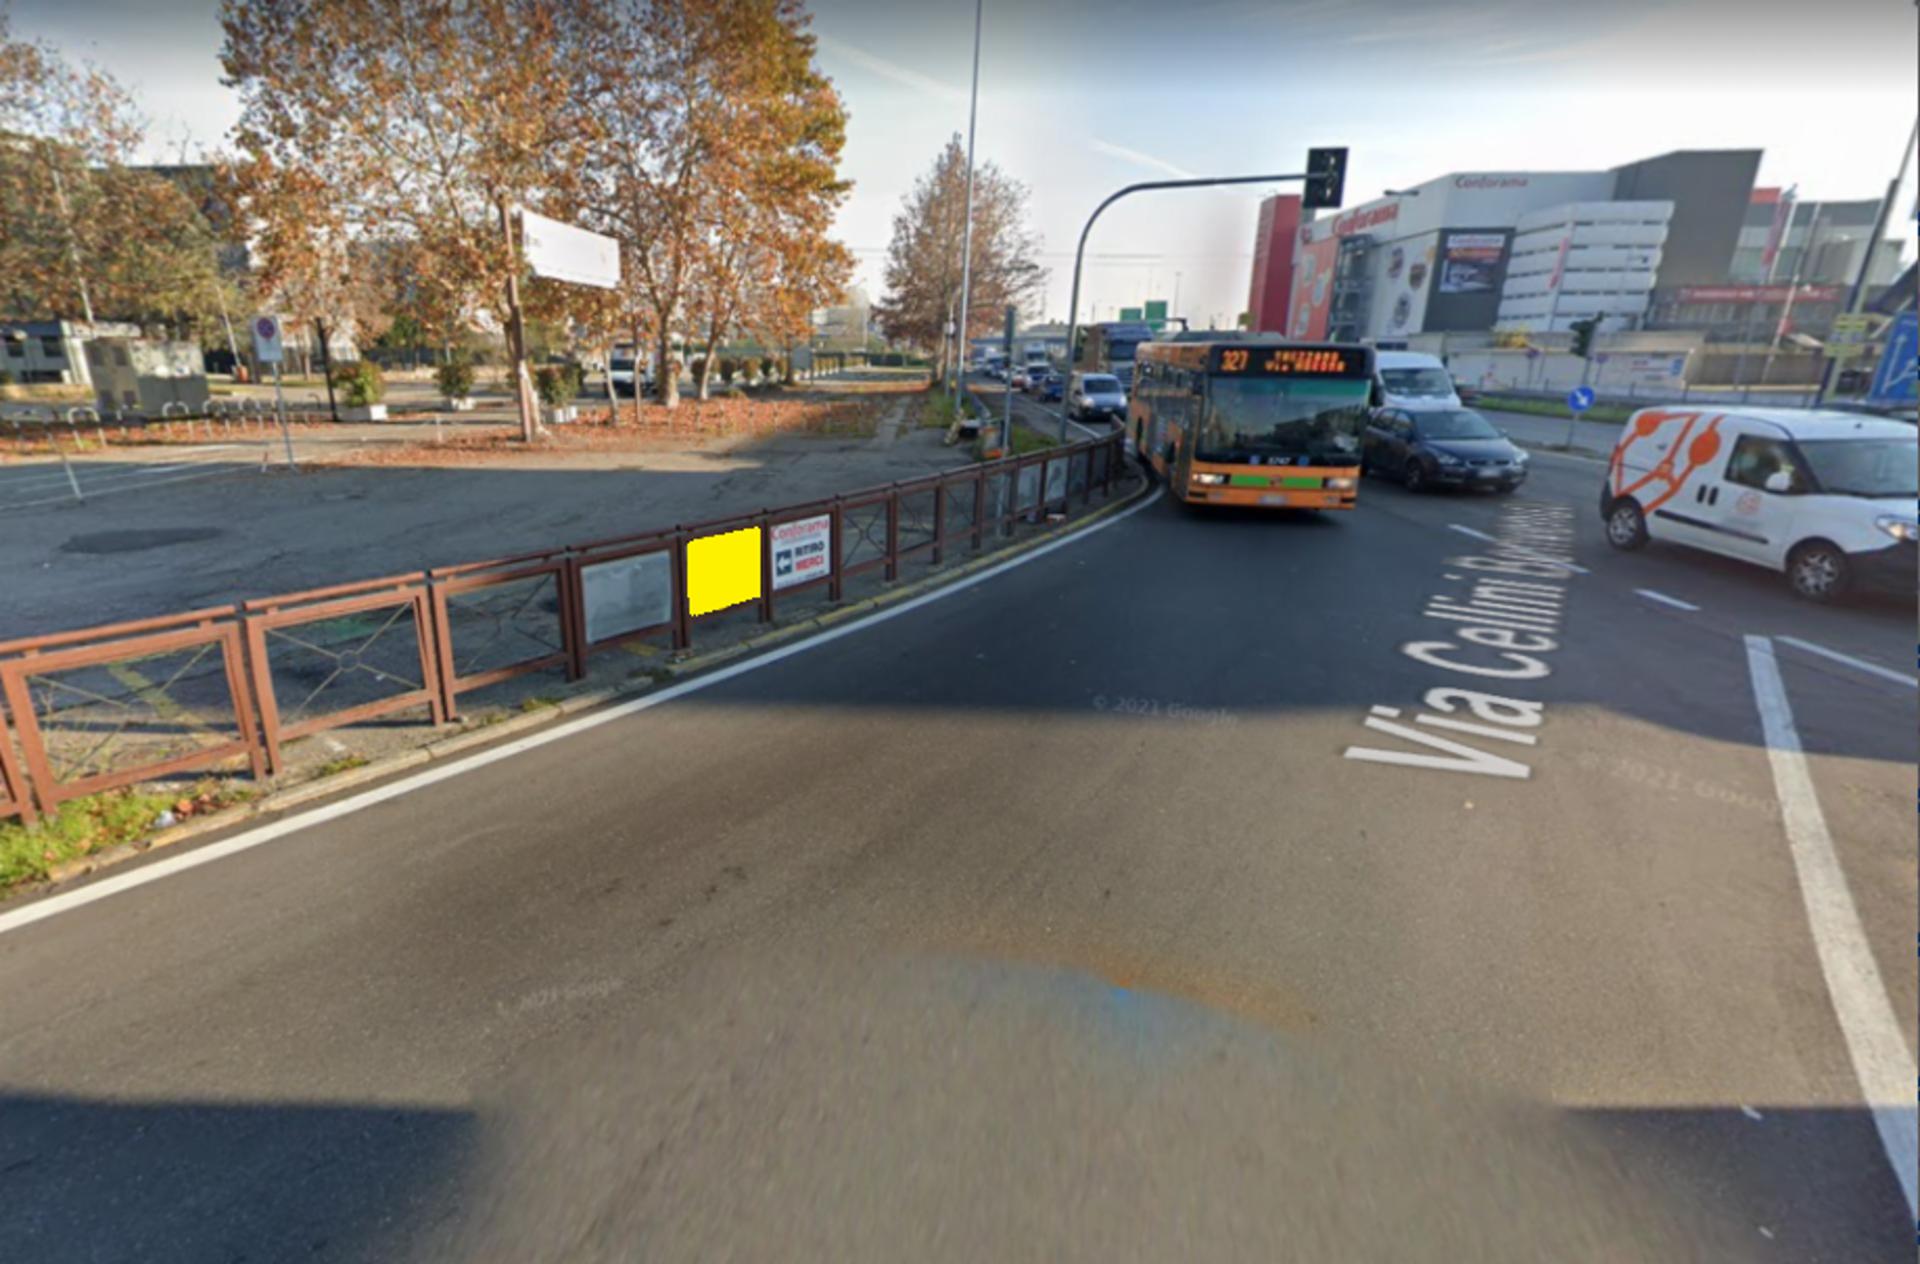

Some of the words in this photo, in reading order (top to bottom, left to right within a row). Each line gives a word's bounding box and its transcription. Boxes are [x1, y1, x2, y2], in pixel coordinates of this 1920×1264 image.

[1455, 174, 1528, 189] Conforama
[1221, 350, 1249, 371] 327
[770, 519, 829, 541] Conforama
[795, 541, 825, 557] RITIRO
[795, 554, 825, 572] MERCI
